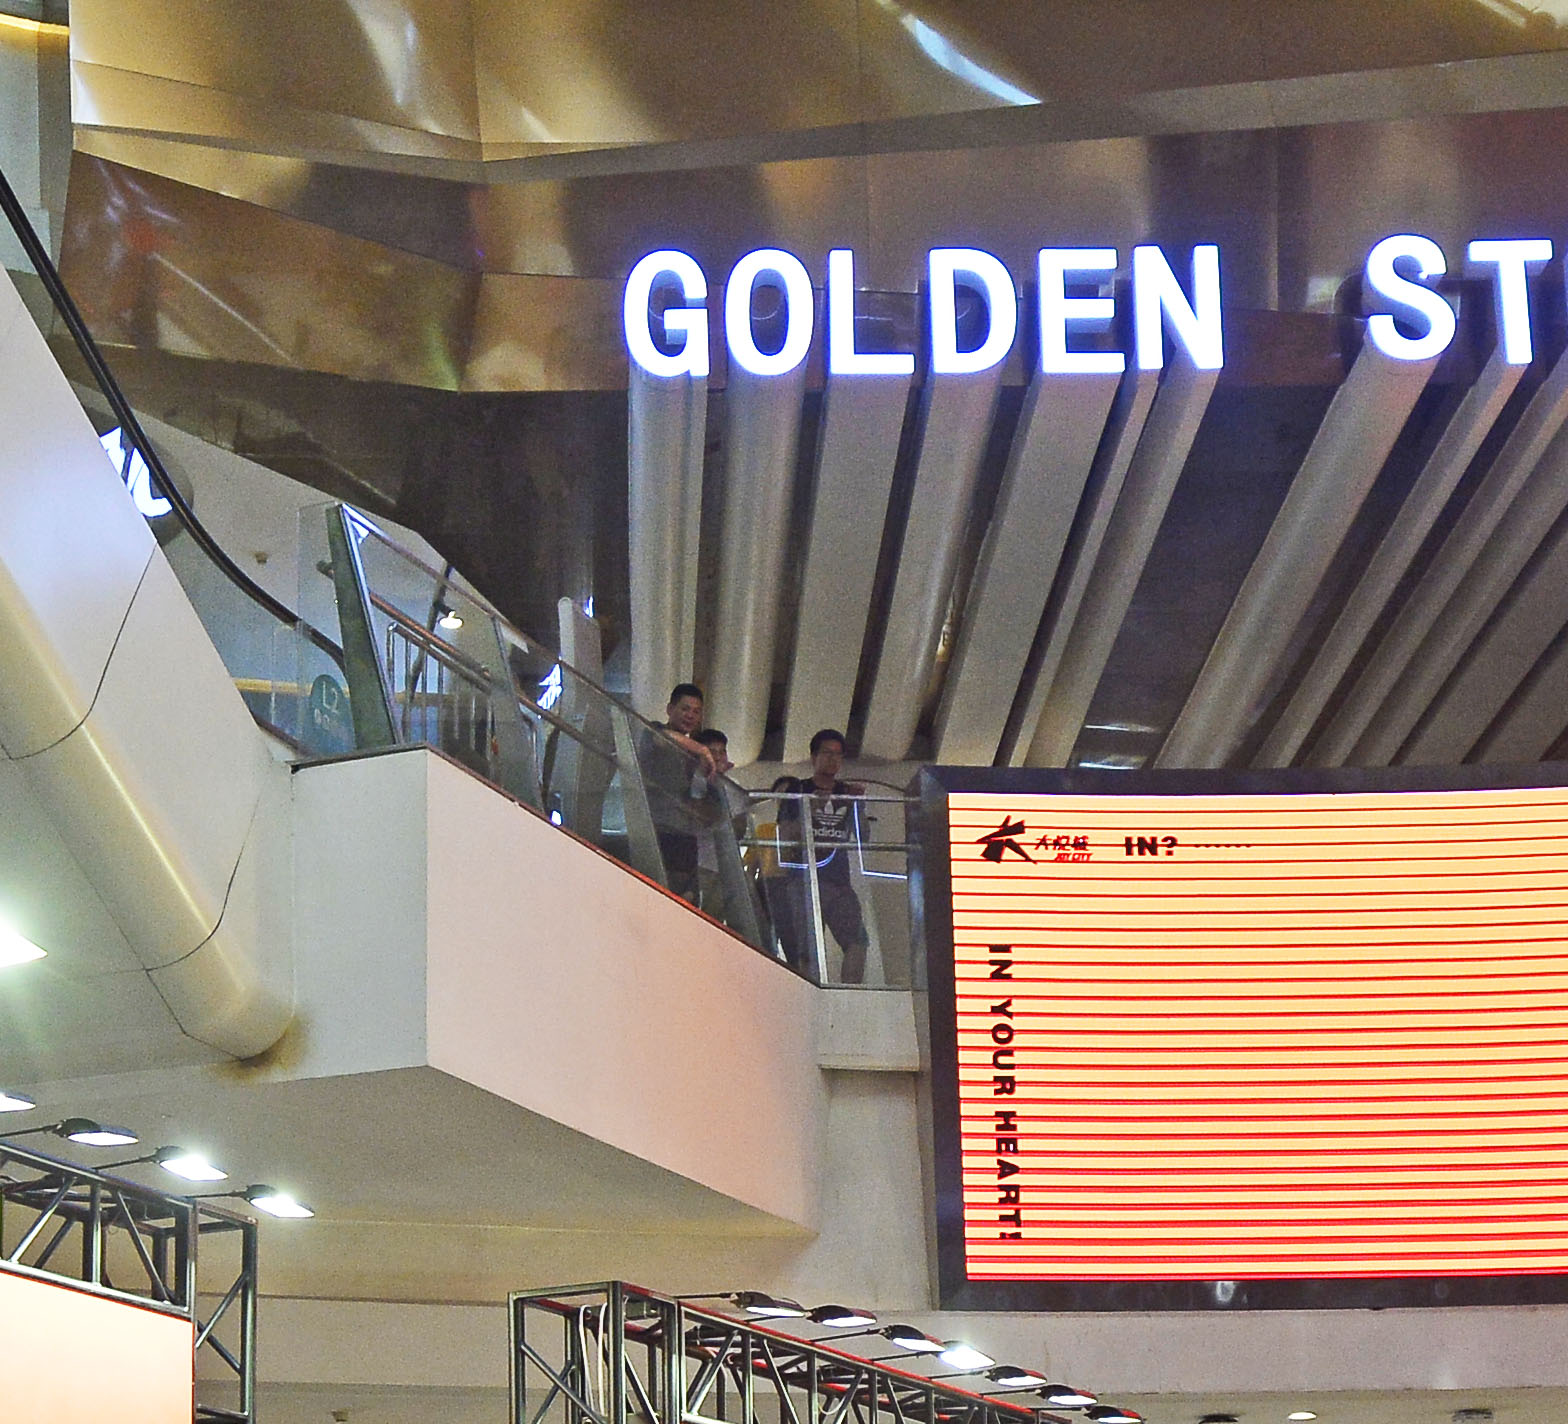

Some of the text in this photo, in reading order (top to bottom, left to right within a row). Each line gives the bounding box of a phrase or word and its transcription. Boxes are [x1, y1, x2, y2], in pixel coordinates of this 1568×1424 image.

[623, 244, 1224, 378] GOLDEN
[1124, 835, 1179, 857] IN?
[988, 944, 1023, 1240] IN YOUR HEART!
